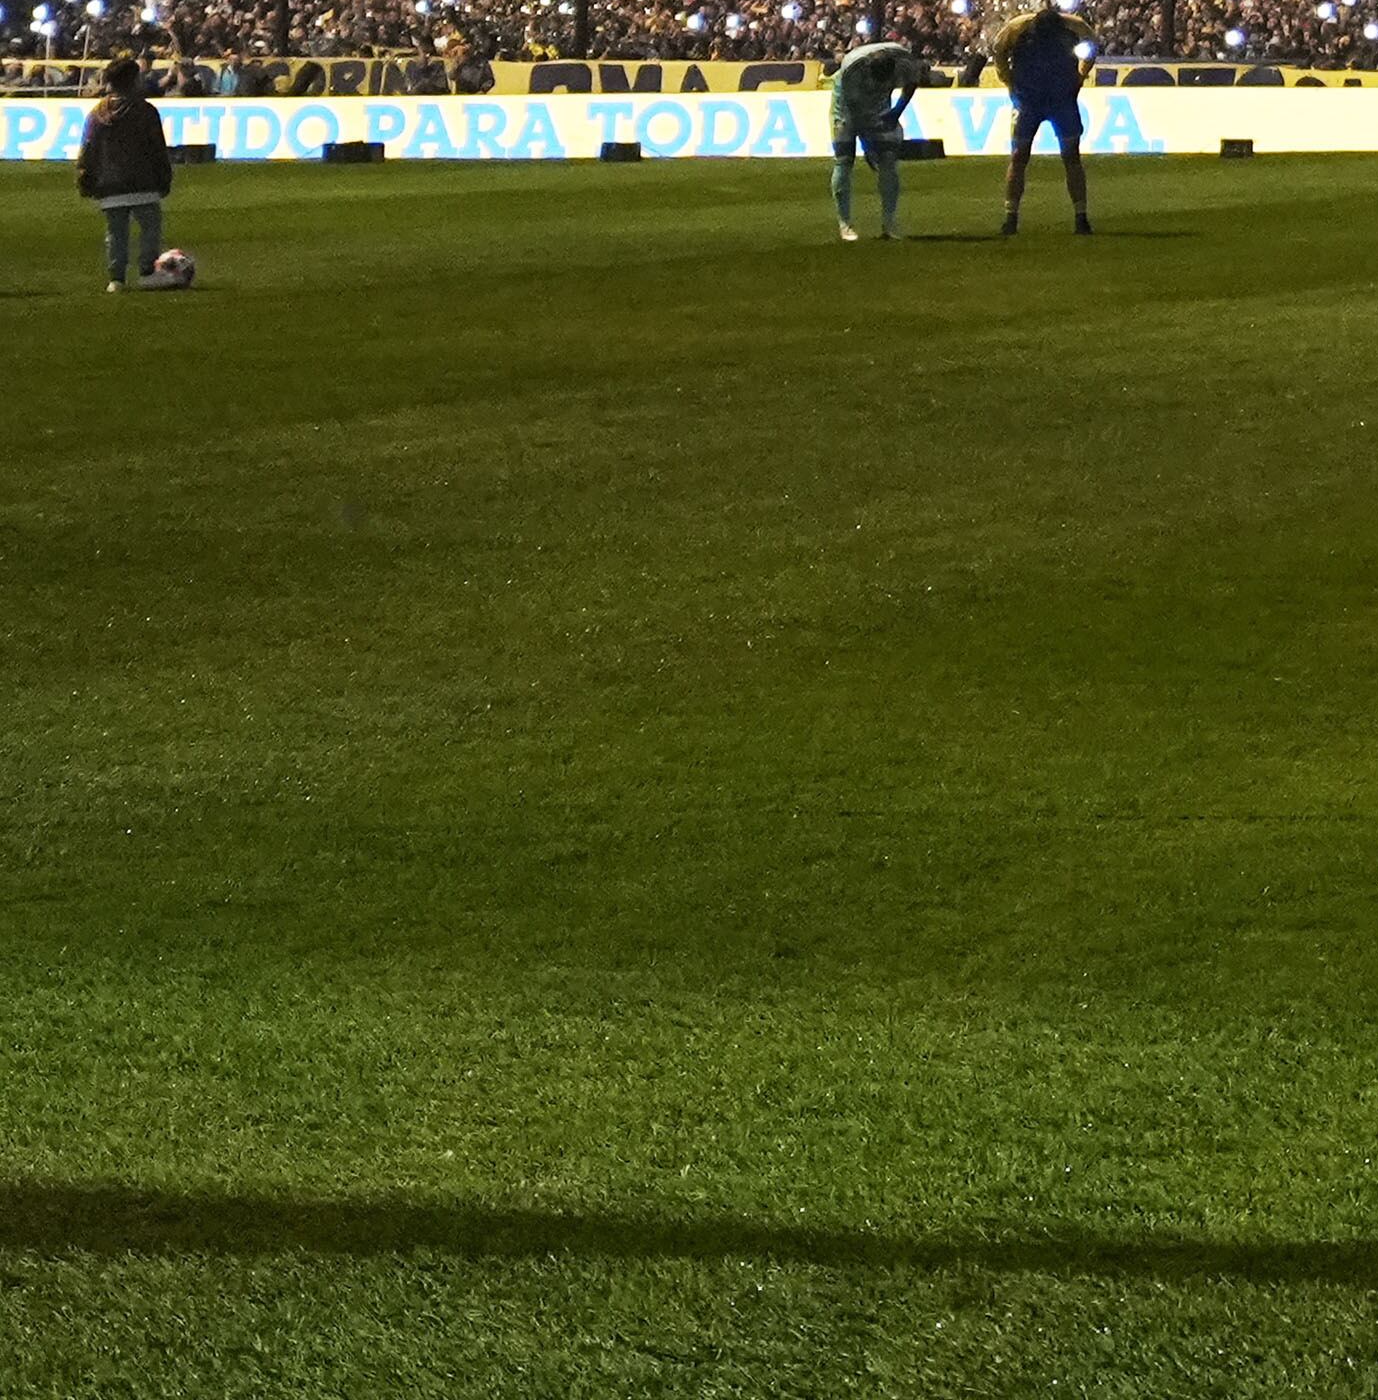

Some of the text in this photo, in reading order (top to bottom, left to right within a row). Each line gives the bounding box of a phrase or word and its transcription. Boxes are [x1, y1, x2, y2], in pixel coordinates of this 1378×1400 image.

[2, 103, 339, 159] PATIDO
[364, 102, 566, 159] PARA
[588, 99, 807, 158] TODA
